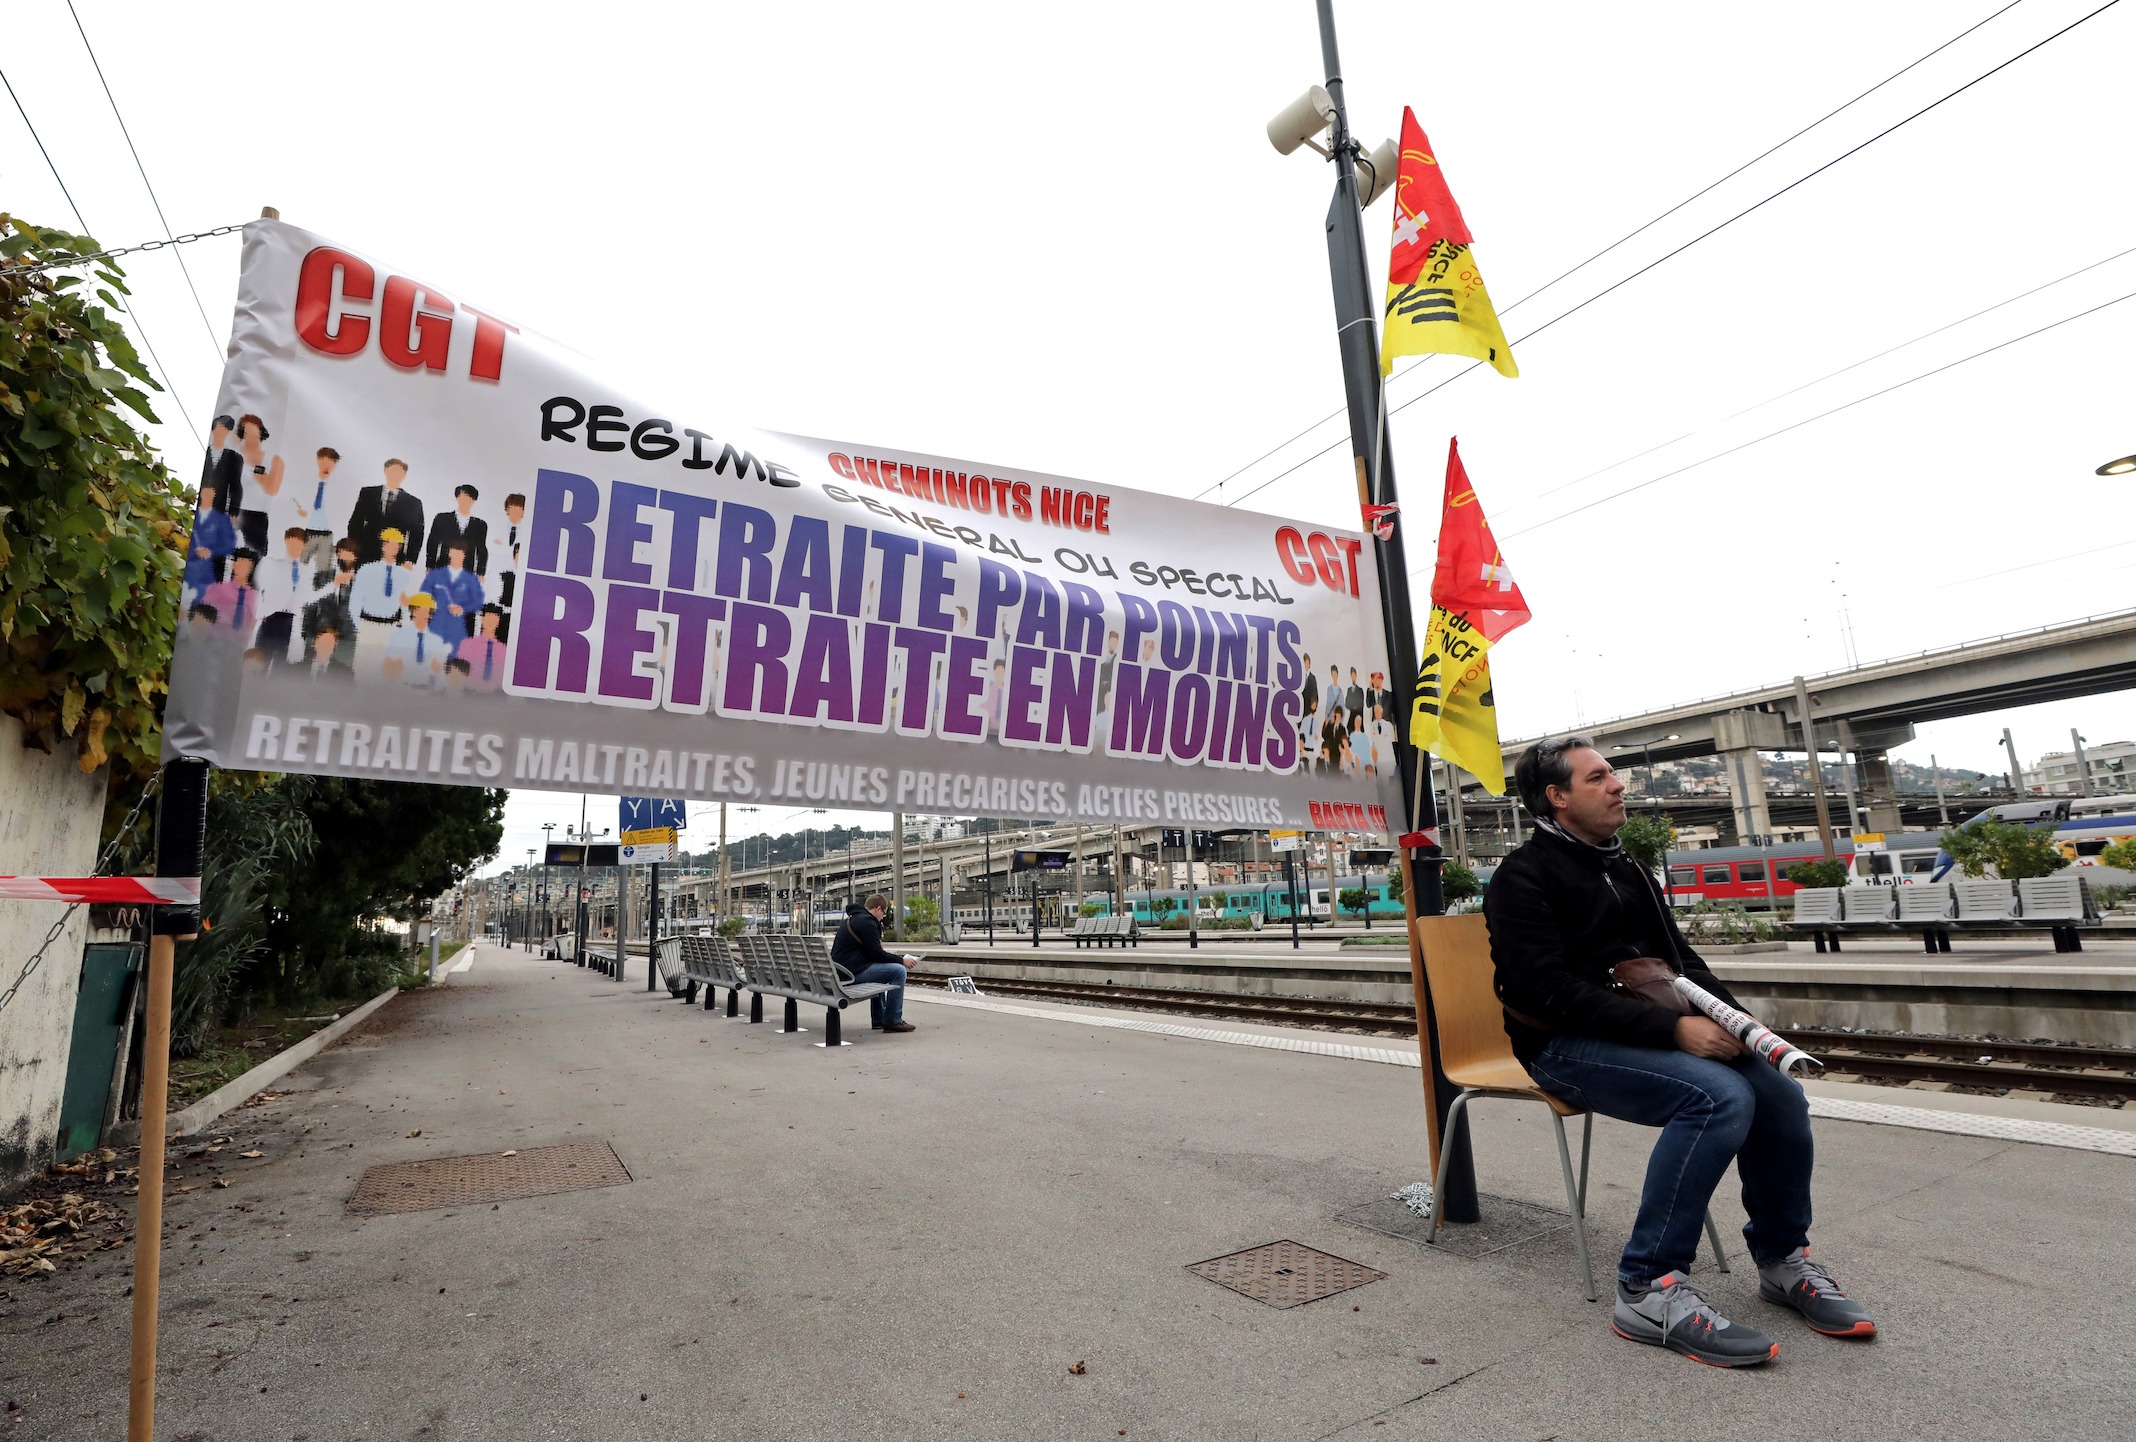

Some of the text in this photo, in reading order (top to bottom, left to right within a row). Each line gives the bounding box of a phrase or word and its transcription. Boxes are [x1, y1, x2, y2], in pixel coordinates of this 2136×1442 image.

[294, 245, 520, 383] CGT
[540, 396, 1295, 605] REGIME GENERAL OU SPECIAL
[828, 452, 1111, 534] CHEMINOTS NICE
[527, 468, 1301, 690] RETRAITE PAR POINTS
[1275, 526, 1361, 598] CGT
[1448, 610, 1473, 633] du
[512, 573, 1300, 770] RETRAITE EN MOINS
[246, 715, 503, 777] RETRAITES
[515, 738, 761, 799] MALTRAITES,
[771, 759, 888, 806] JEUNES
[897, 770, 1072, 817] PRECARISES,
[1077, 785, 1160, 821] ACTIFS
[1163, 793, 1284, 826] PRESSURES
[628, 798, 677, 819] Y A
[1173, 834, 1181, 847] T
[1195, 834, 1203, 847] T
[1308, 800, 1368, 832] BASTA
